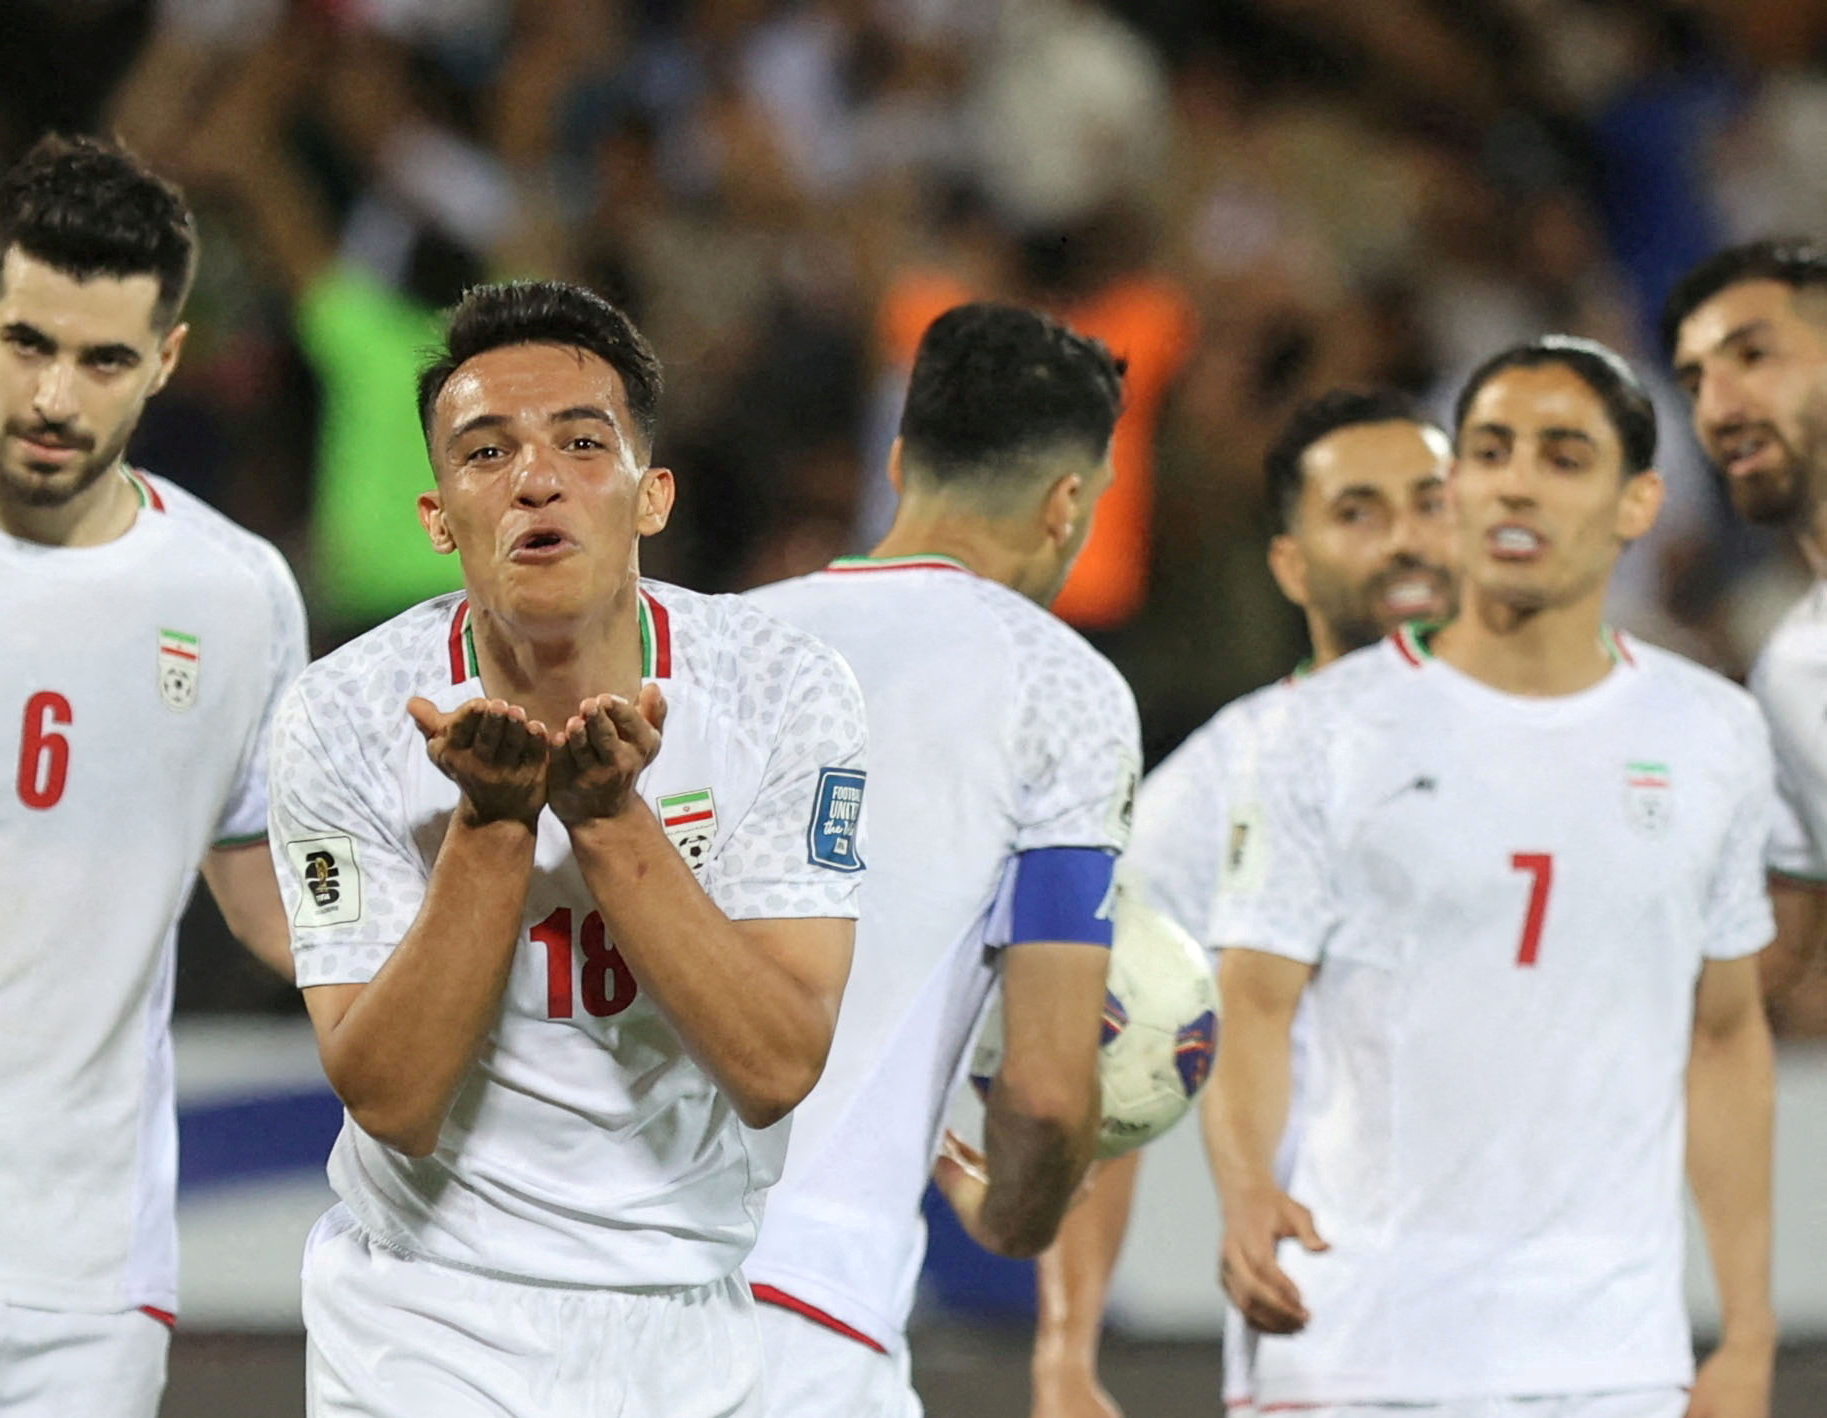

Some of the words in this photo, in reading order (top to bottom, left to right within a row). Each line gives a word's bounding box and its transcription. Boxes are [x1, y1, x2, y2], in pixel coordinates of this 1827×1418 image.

[16, 690, 73, 810] 6
[529, 906, 638, 1019] 18
[1510, 852, 1553, 966] 7
